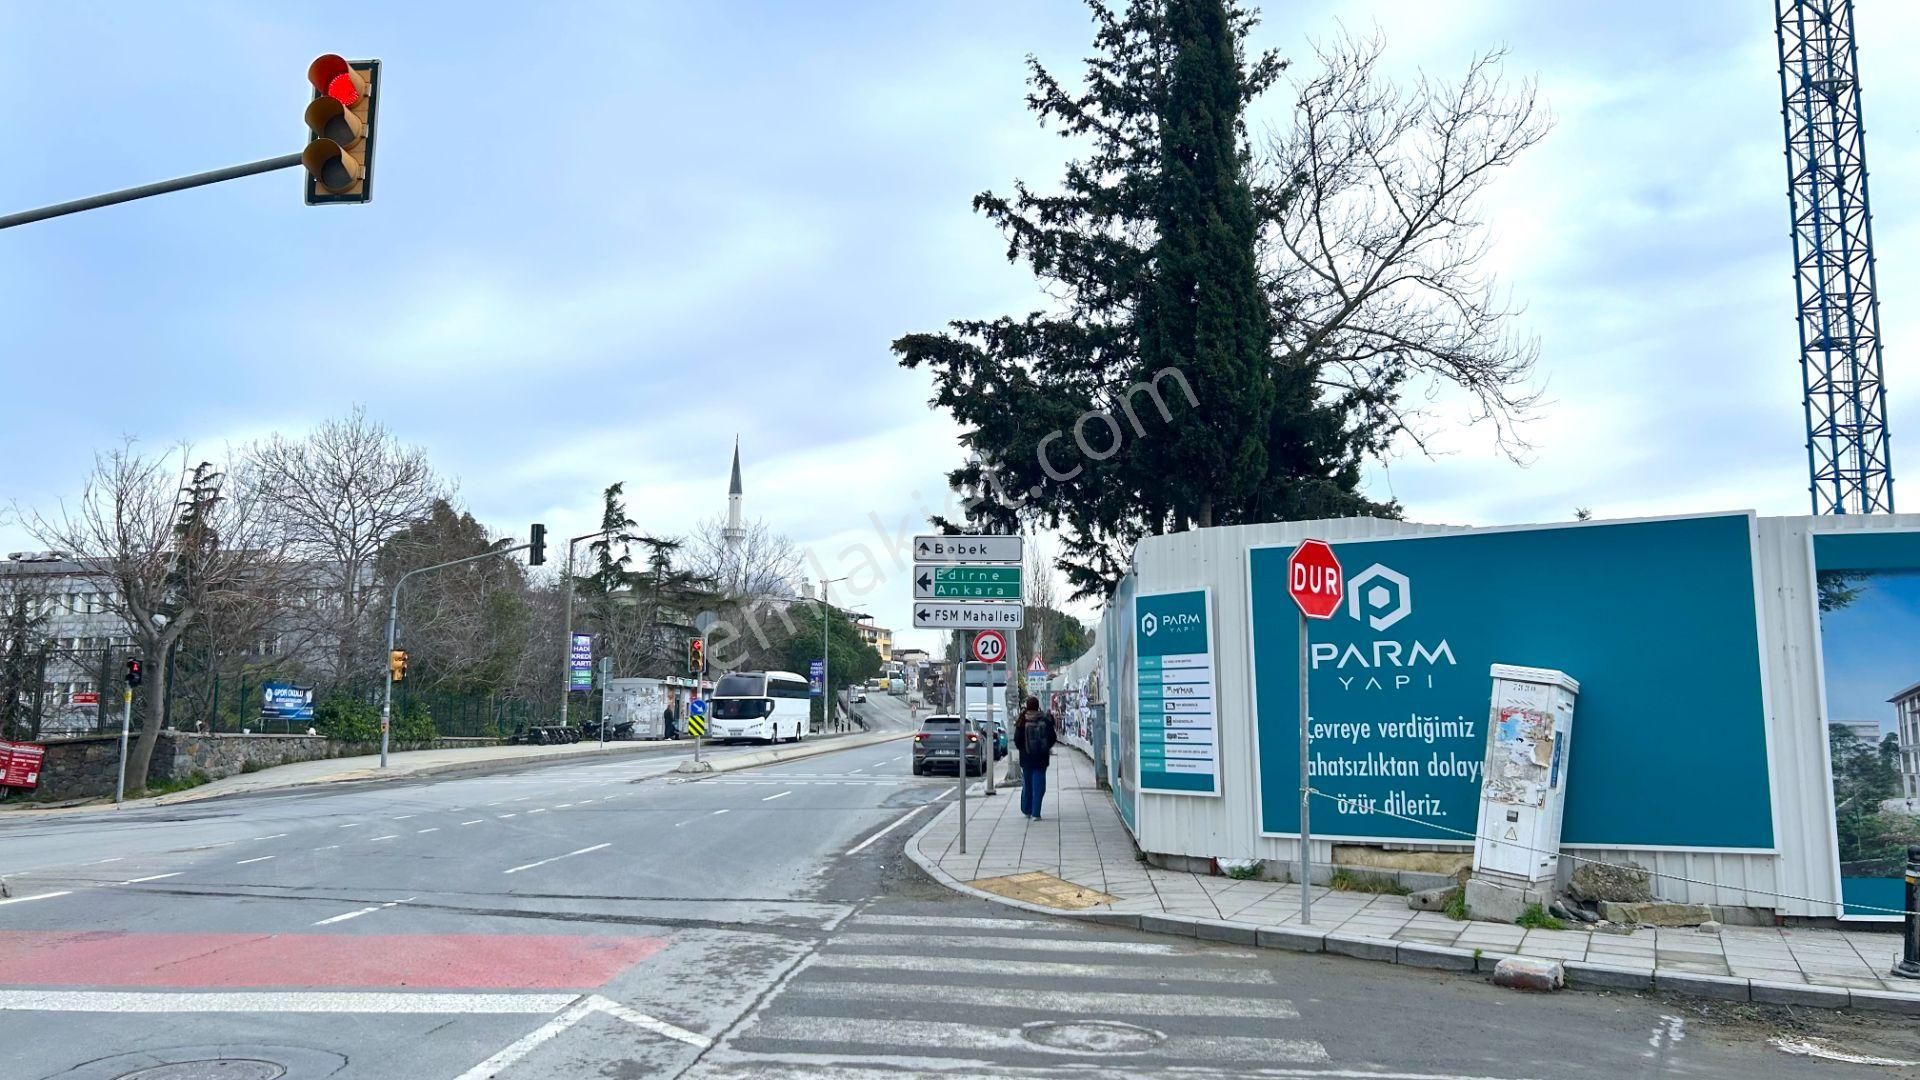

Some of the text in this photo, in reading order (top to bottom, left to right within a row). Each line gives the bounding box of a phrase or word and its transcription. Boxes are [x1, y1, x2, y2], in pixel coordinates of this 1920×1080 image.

[935, 543, 988, 555] Bebek
[936, 568, 1000, 580] Edirne
[1294, 562, 1338, 595] DUR
[936, 584, 1004, 595] Ankara
[935, 610, 1019, 622] FSM Mahallesi
[1162, 613, 1200, 626] PARM
[981, 640, 1000, 655] 20
[1311, 638, 1457, 670] PARM
[1338, 674, 1433, 691] YAPI
[1377, 713, 1476, 744] verdiğimiz
[1307, 752, 1419, 777] ahatsızlıktan
[1337, 790, 1447, 816] özür dileriz.
